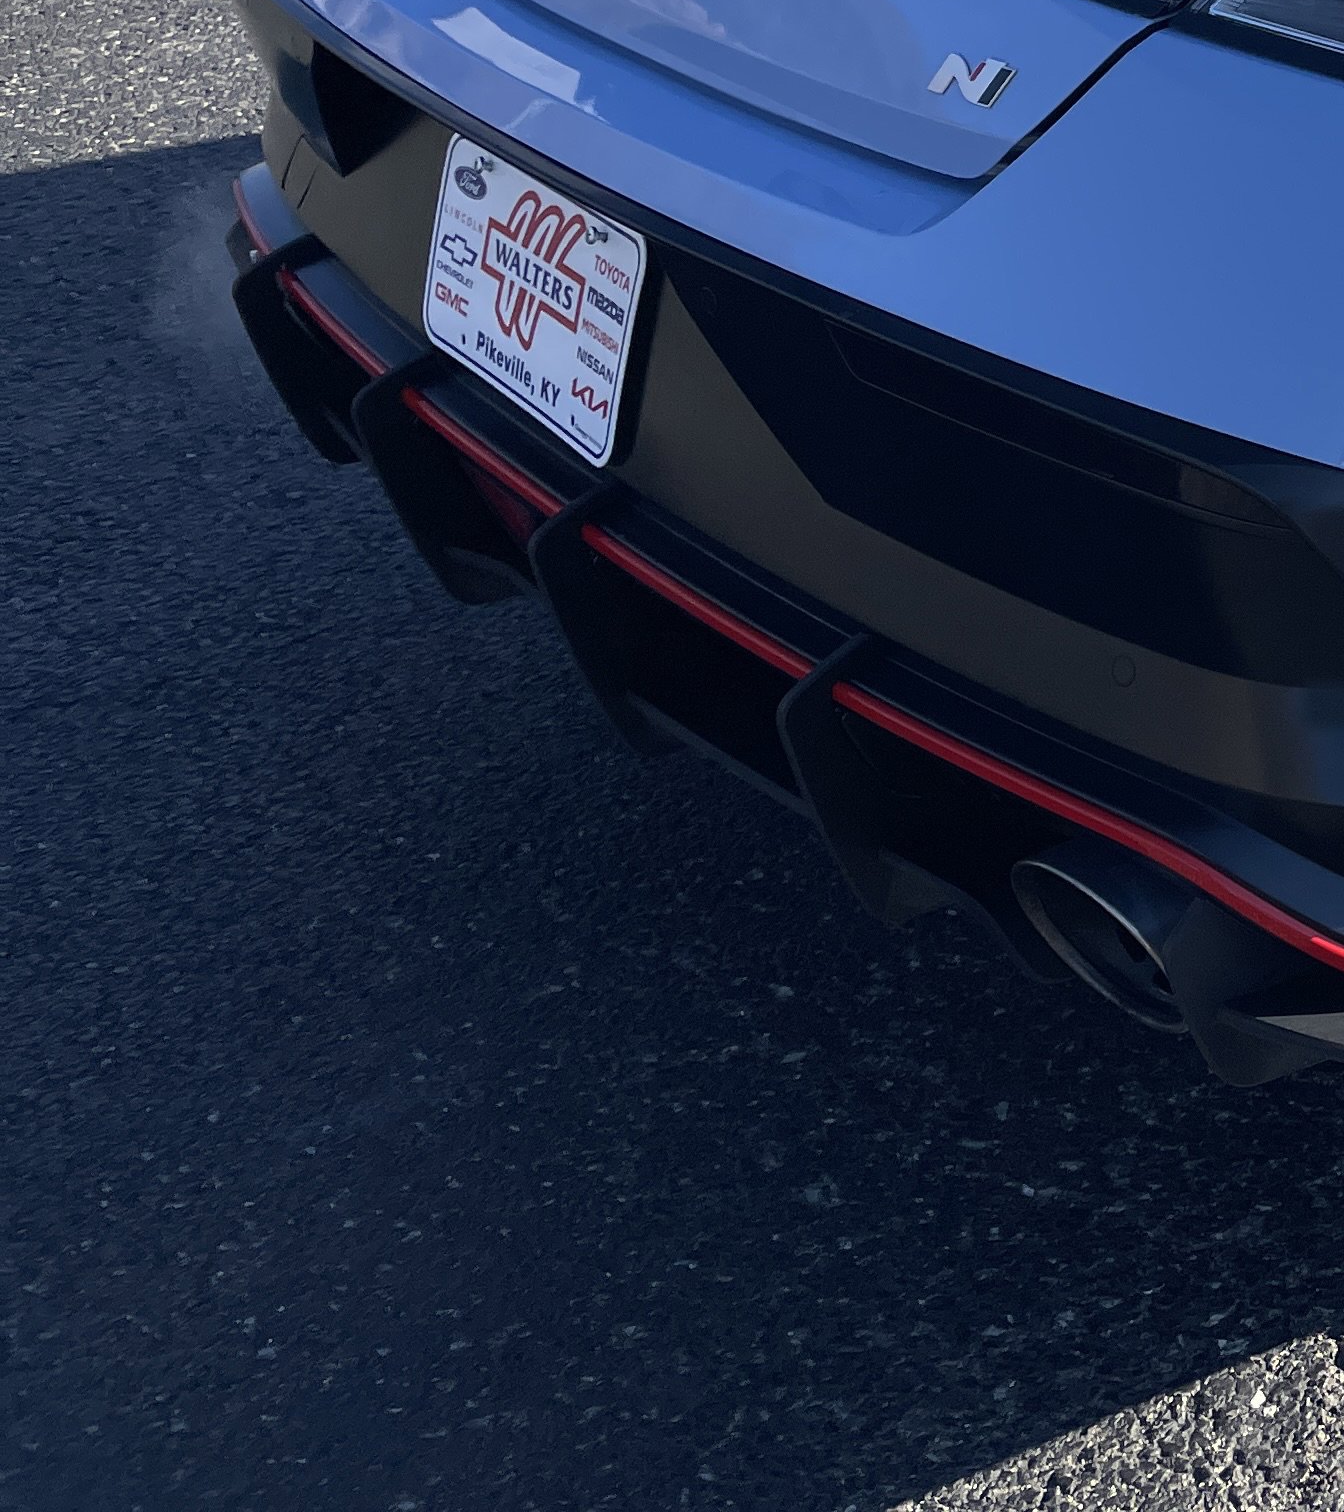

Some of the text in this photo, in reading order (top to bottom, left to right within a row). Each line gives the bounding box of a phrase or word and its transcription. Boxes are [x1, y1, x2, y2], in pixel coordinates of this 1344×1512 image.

[444, 203, 485, 234] LINCOLN
[436, 259, 474, 289] CHEVROLET
[495, 238, 574, 311] WALTERS
[595, 254, 630, 294] TOYOTA
[435, 281, 470, 318] GMC
[582, 318, 620, 355] MITSUBISHI
[475, 331, 561, 408] Pikeville, KY
[576, 346, 614, 385] NISSAN
